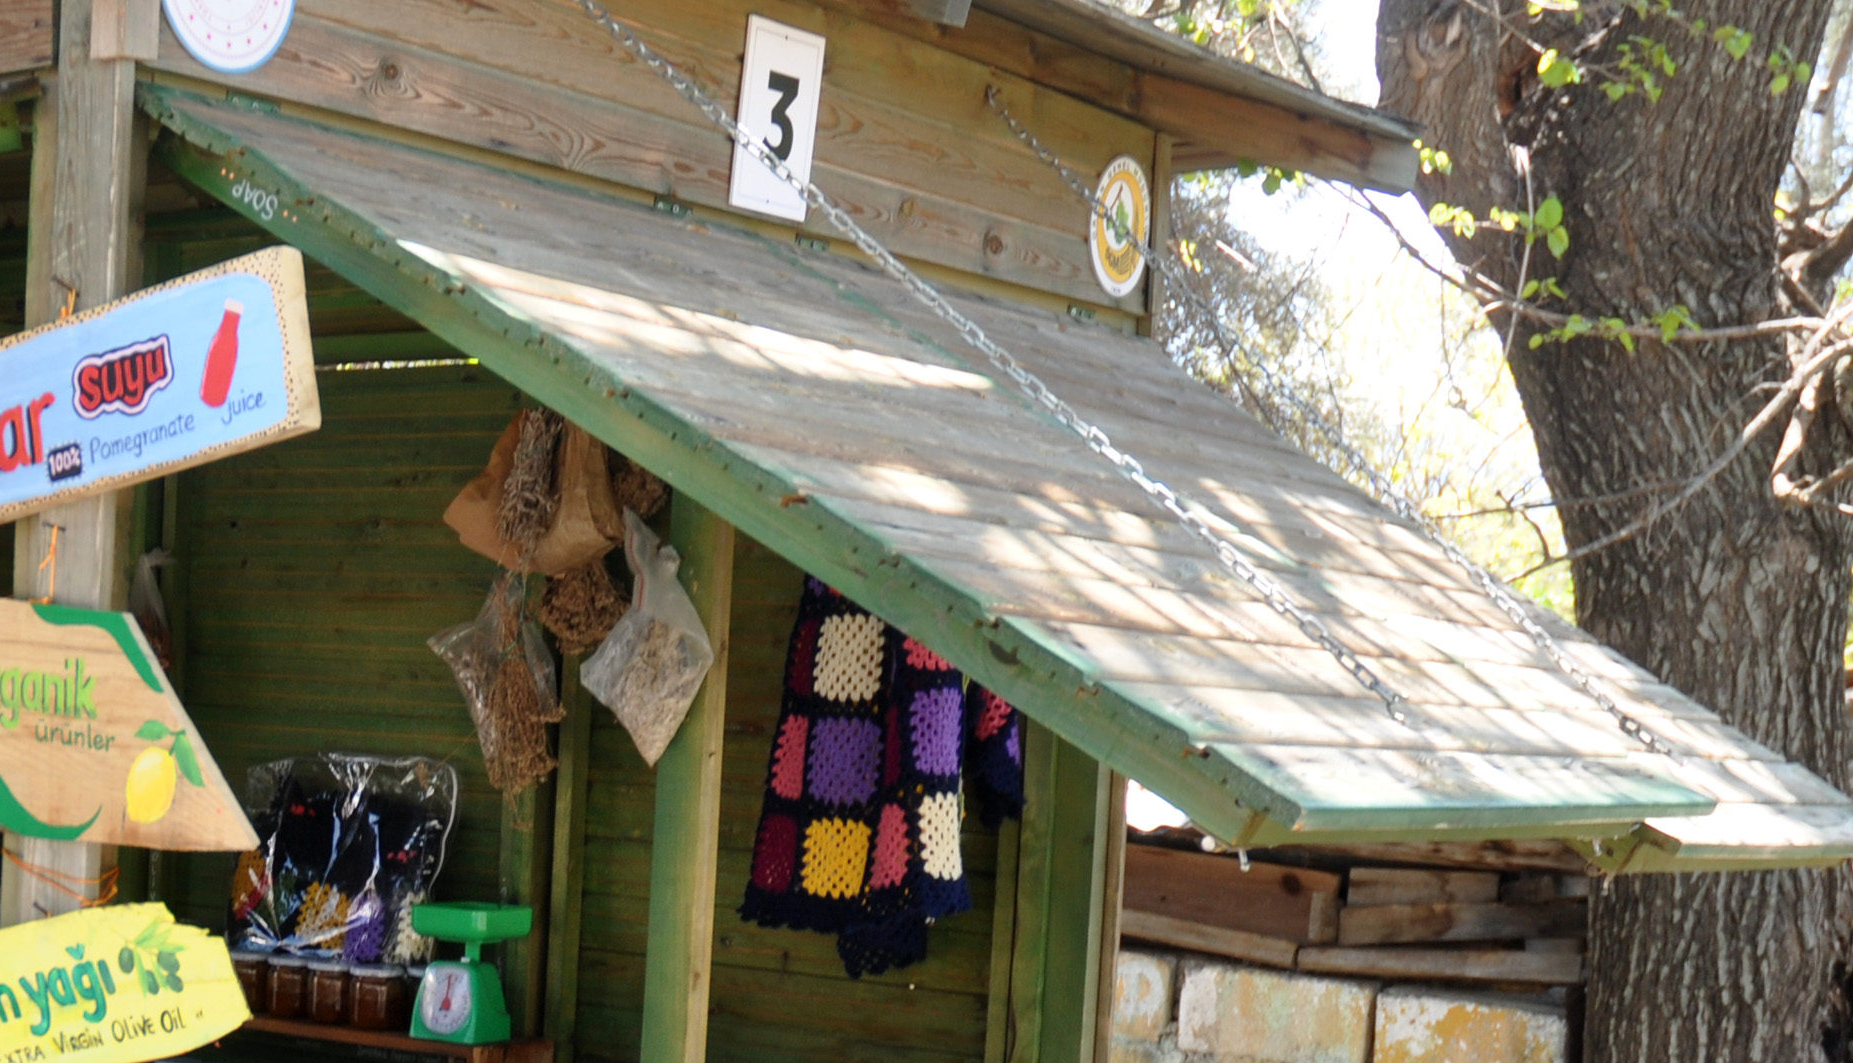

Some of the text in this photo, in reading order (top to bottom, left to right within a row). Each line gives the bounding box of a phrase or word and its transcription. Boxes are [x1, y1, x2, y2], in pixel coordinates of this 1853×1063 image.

[762, 69, 801, 162] 3
[78, 343, 167, 411] suyu
[48, 388, 267, 477] 100% Pomegranate juice
[34, 719, 116, 753] ürünler
[18, 943, 117, 1037] yağı
